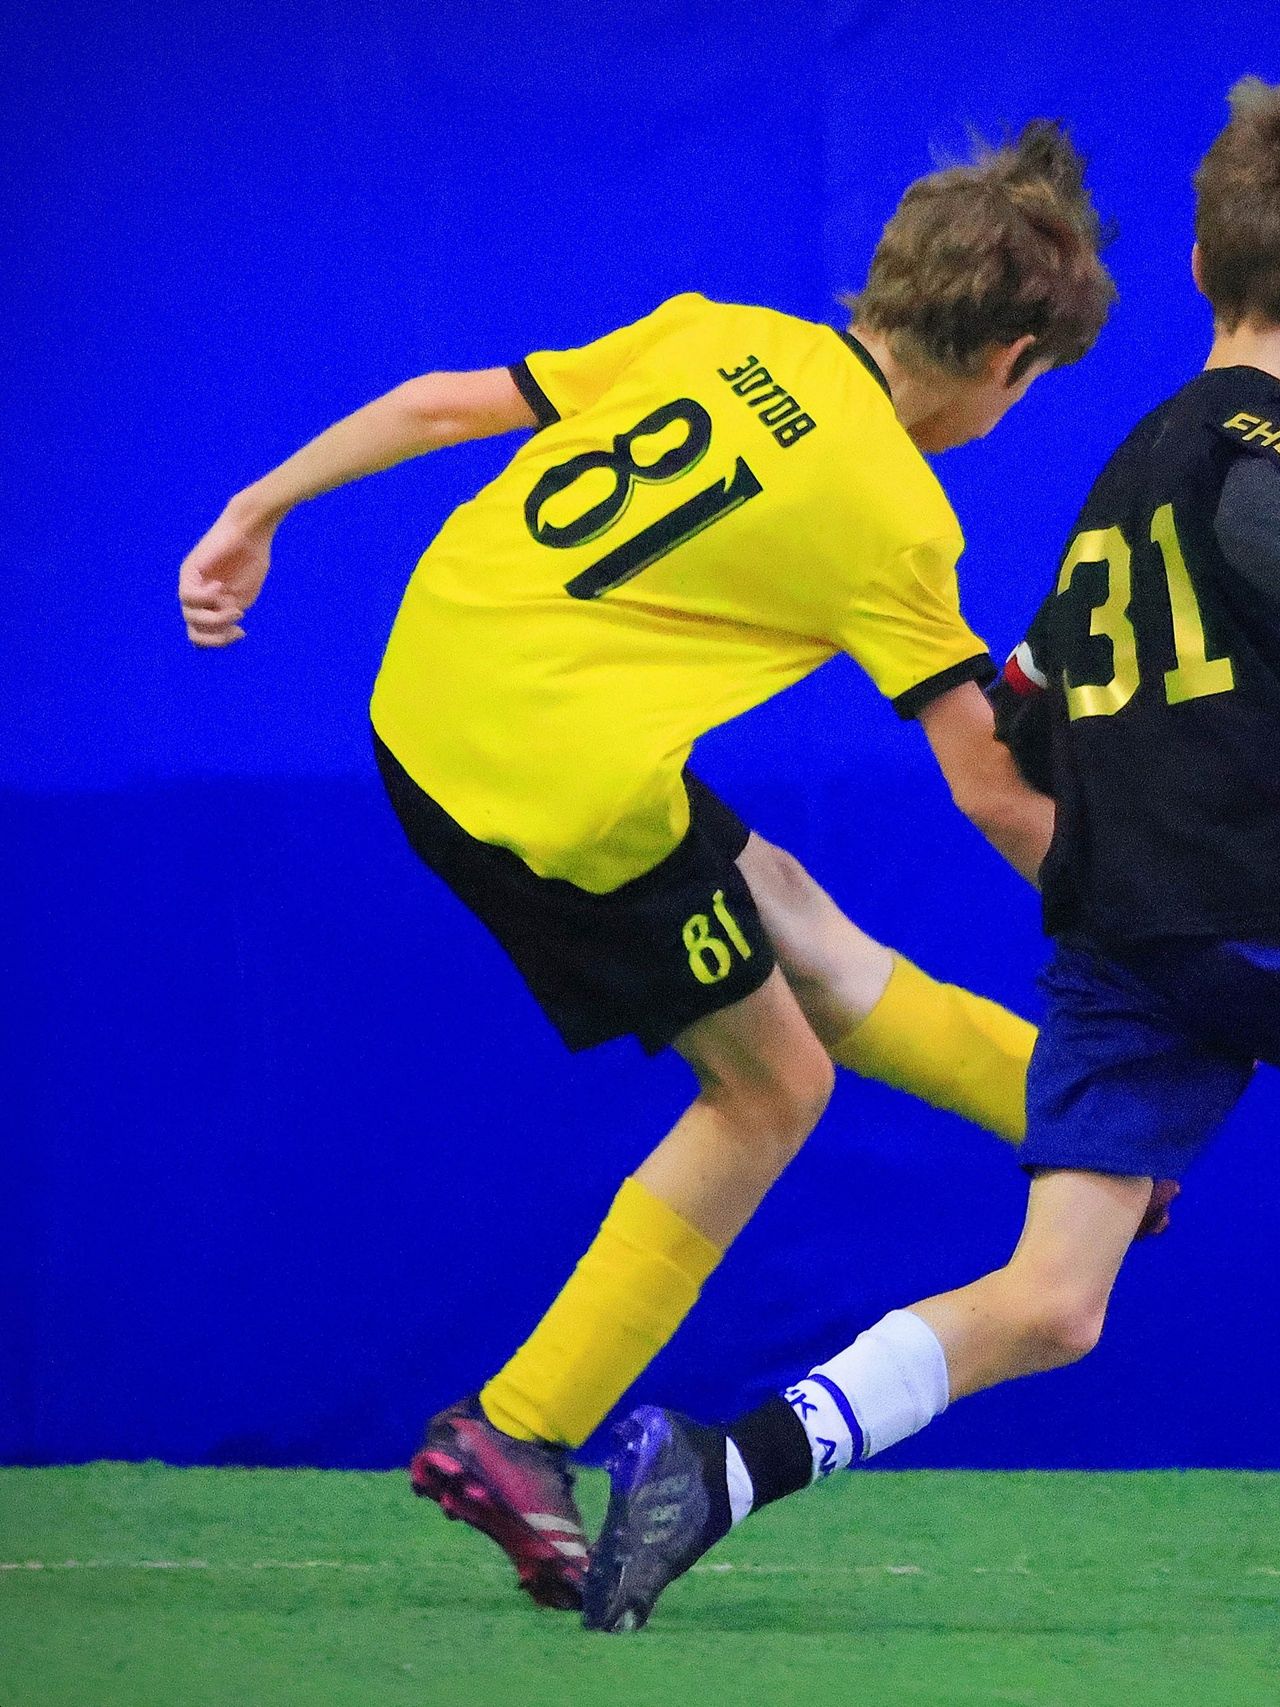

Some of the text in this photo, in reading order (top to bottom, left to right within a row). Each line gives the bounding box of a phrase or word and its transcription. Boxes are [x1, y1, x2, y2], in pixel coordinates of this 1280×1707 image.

[716, 354, 818, 449] ЗОТОВ
[523, 397, 764, 601] 81
[1056, 502, 1235, 722] 31
[682, 889, 752, 985] 81
